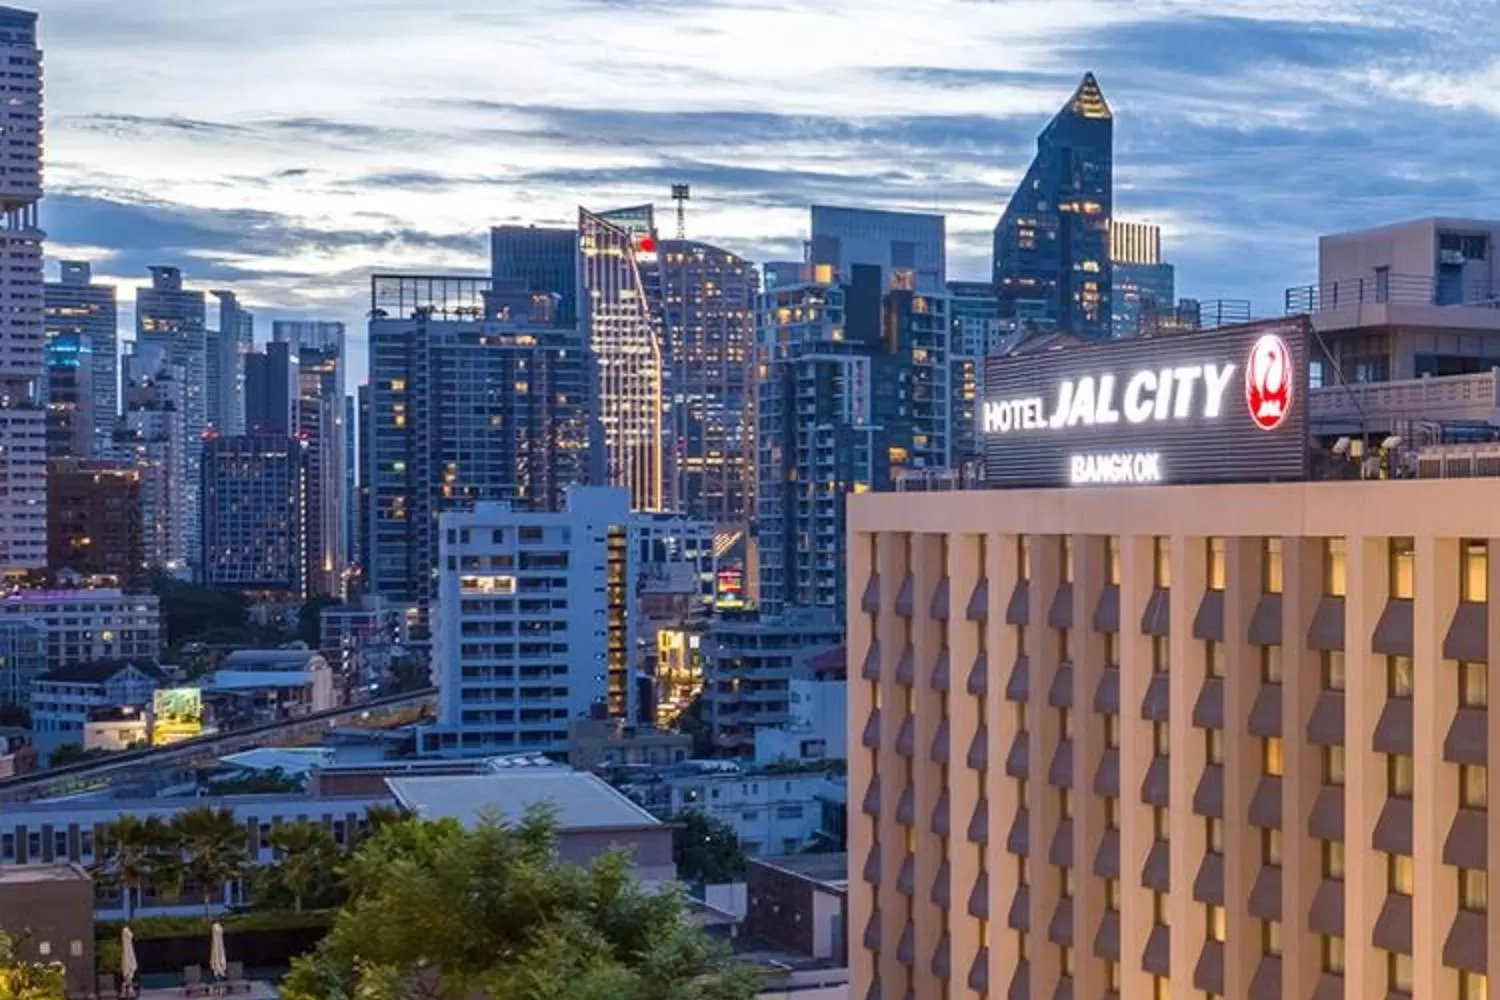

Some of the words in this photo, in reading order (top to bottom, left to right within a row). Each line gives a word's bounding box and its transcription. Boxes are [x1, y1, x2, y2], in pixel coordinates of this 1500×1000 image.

[983, 397, 1048, 432] HOTEL
[1050, 375, 1119, 429] JAL
[1124, 362, 1236, 423] CITY
[1071, 452, 1161, 483] BANGKOK
